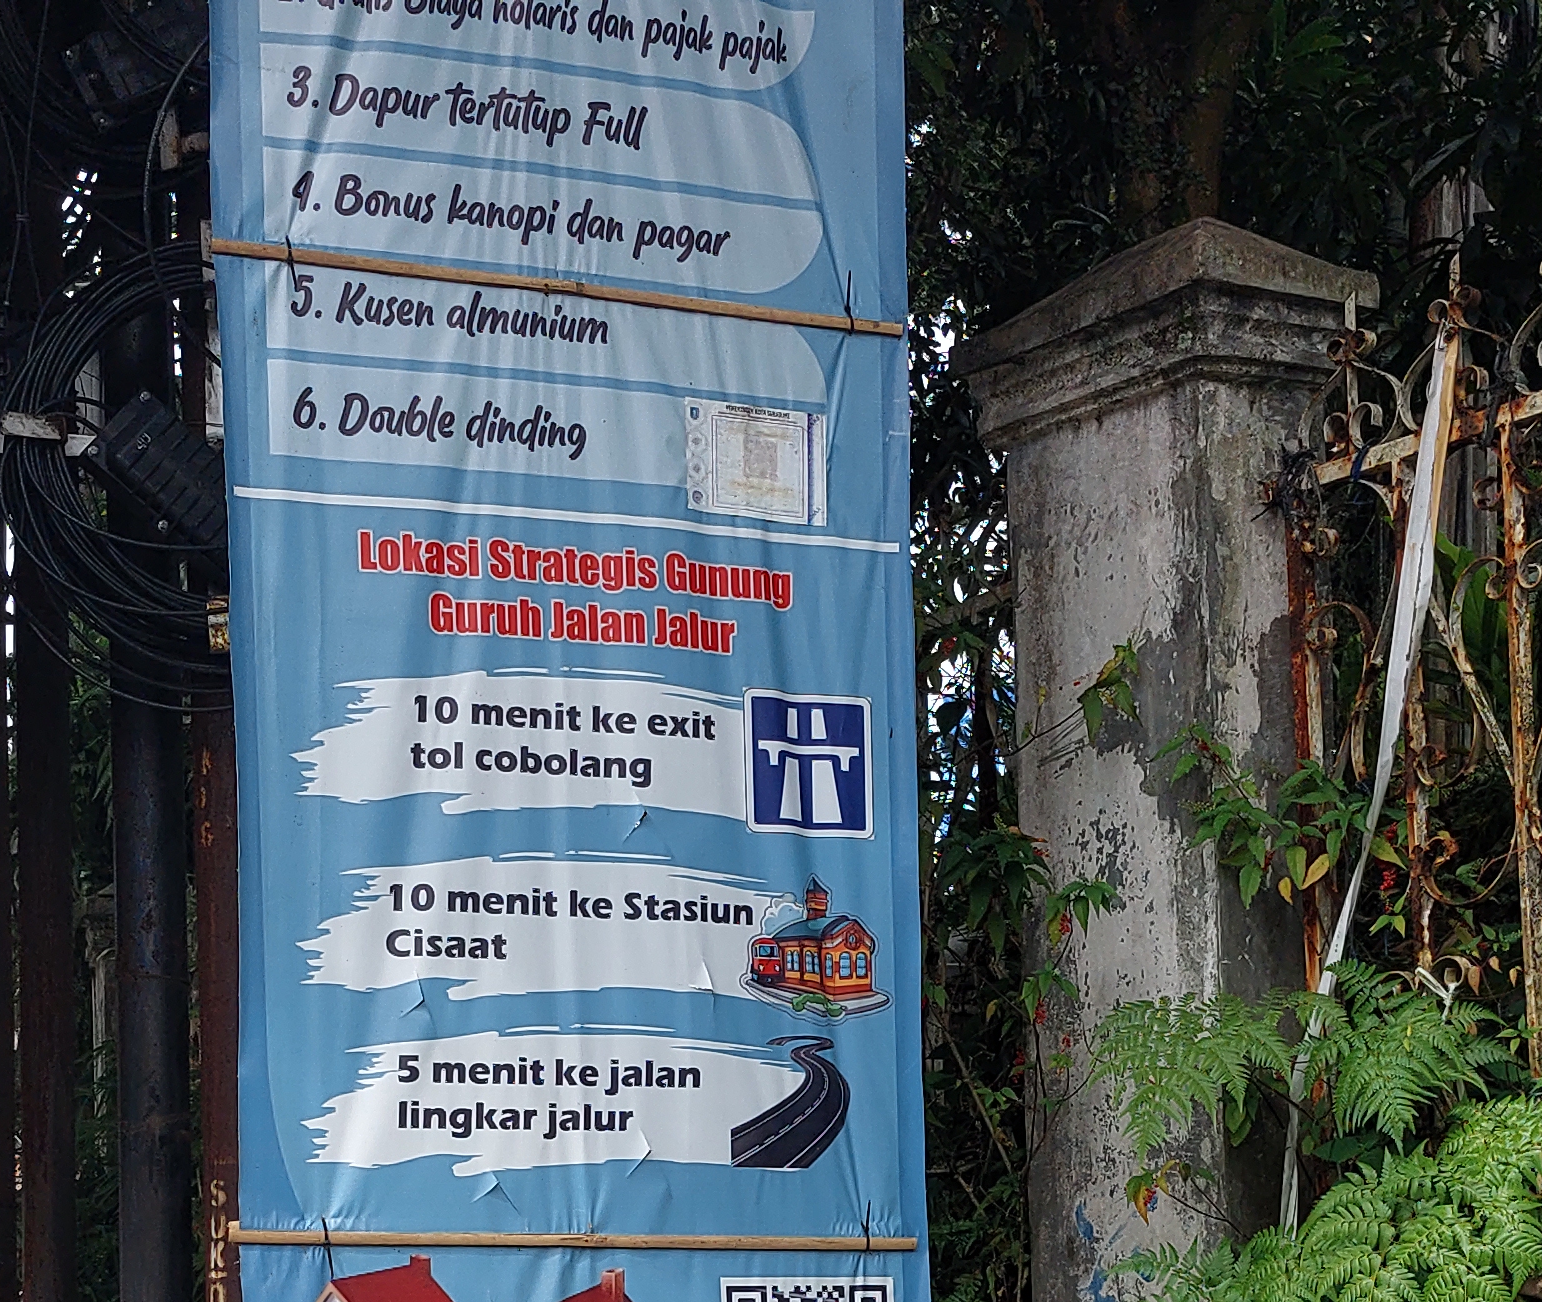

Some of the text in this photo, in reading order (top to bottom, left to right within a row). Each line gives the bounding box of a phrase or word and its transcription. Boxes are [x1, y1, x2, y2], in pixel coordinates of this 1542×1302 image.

[589, 3, 634, 42] dan
[642, 14, 714, 60] pajak
[720, 20, 788, 74] pajak
[286, 65, 320, 108] 3.
[328, 73, 438, 128] Dapur
[581, 101, 649, 151] Full
[291, 171, 731, 263] 4. Bonus kanopi dan pagar
[290, 275, 609, 345] 5. Kusen almunium
[293, 387, 587, 460] 6. Double dinding
[358, 530, 792, 611] Lokasi Strategis Gunung
[429, 592, 737, 655] Guruh Jalan Jalur
[414, 694, 717, 741] 10 menit ke exit
[410, 741, 652, 788] tol cobolang
[389, 883, 754, 927] 10 menit ke Stasiun
[385, 928, 507, 960] Cisaat
[397, 1055, 701, 1094] 5 menit ke jalan
[397, 1101, 634, 1138] lingkar jalur
